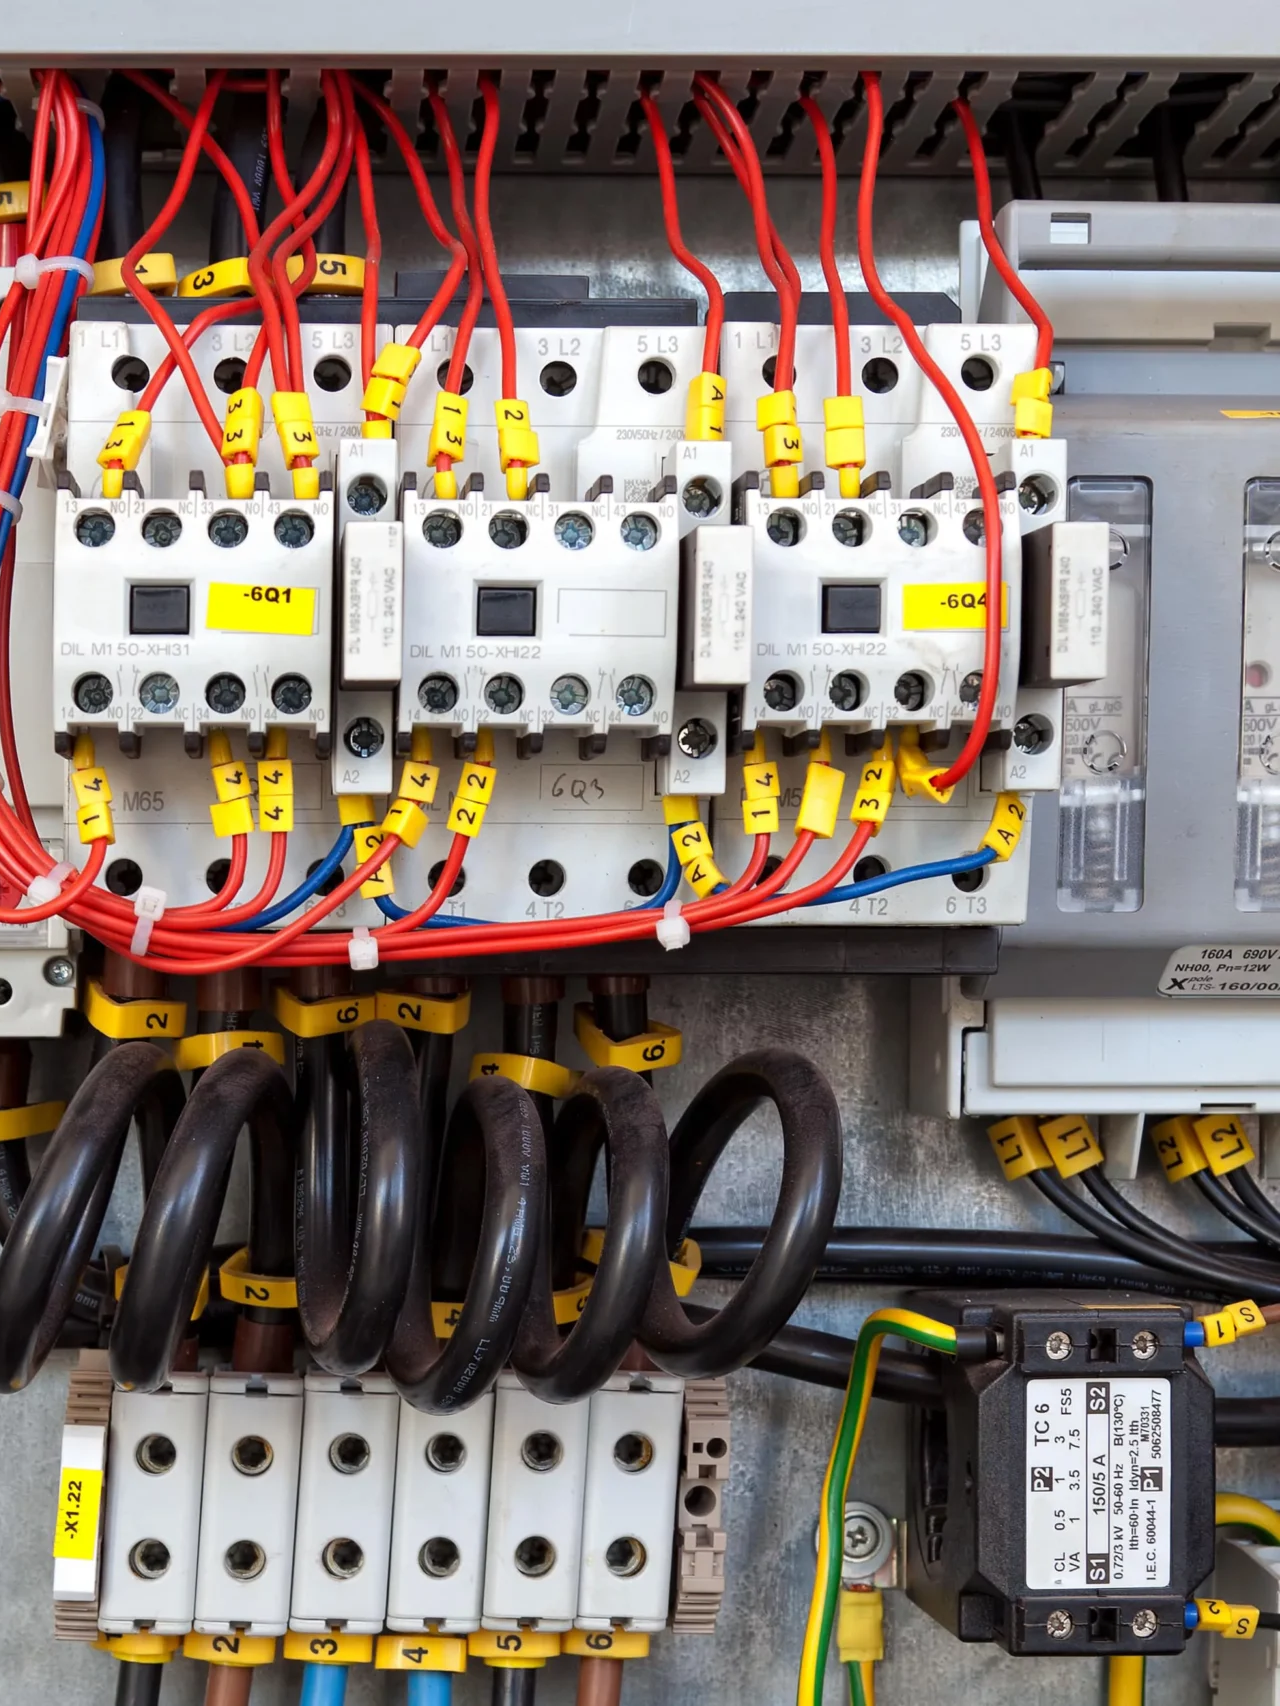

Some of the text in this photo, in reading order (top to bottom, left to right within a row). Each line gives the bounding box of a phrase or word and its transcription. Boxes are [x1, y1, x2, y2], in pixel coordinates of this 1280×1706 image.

[320, 260, 346, 275] 5
[193, 272, 214, 290] 3
[101, 331, 119, 347] L1
[212, 334, 222, 351] 3
[312, 332, 354, 349] 5 L3
[538, 339, 580, 355] 3 L2
[637, 336, 678, 353] 5 L3
[861, 337, 902, 354] 3 L2
[961, 334, 1002, 350] 5 L3
[349, 444, 364, 456] A1
[684, 447, 696, 460] A1
[1020, 445, 1033, 456] A1
[314, 503, 328, 515] NO
[244, 587, 291, 604] -6Q1
[940, 594, 987, 609] -6Q4
[61, 644, 84, 655] DIL
[410, 646, 432, 658] DIL
[758, 644, 779, 656] DIL
[62, 706, 74, 718] 14
[108, 707, 123, 719] NO
[131, 707, 143, 720] 22
[175, 708, 188, 720] NC
[197, 708, 209, 720] 34
[241, 708, 256, 720] NO
[264, 708, 277, 720] 44
[310, 709, 324, 721] NO
[408, 710, 420, 721] 14
[343, 771, 359, 783] A2
[674, 770, 690, 783] A2
[1010, 766, 1026, 779] A2
[123, 791, 164, 811] M65
[525, 902, 565, 918] 4 T2
[849, 898, 888, 915] 4 T2
[946, 896, 987, 913] 6 T3
[1201, 949, 1233, 959] 160A
[1175, 964, 1271, 972] NH00, Pn=12W
[398, 1002, 421, 1021] 2
[146, 1012, 168, 1029] 2
[997, 1133, 1022, 1164] L1
[1058, 1126, 1091, 1159] L1
[1211, 1123, 1244, 1159] L2
[1159, 1136, 1182, 1170] L2
[245, 1285, 269, 1300] 2
[1061, 1388, 1072, 1415] FS5
[1141, 1406, 1150, 1442] M70331
[1152, 1390, 1162, 1459] 5062508477
[1034, 1403, 1050, 1490] P2 TC 6
[1069, 1429, 1080, 1450] 7.5
[1114, 1464, 1123, 1478] Hz
[1144, 1468, 1159, 1490] P1
[1070, 1470, 1080, 1490] 3.5
[1090, 1387, 1106, 1581] S1 150/5 A S2
[1114, 1483, 1123, 1515] 50-60
[64, 1480, 82, 1539] -X1.22
[1055, 1510, 1065, 1530] 0.5
[1114, 1526, 1123, 1541] kV
[1147, 1500, 1156, 1580] I.E.C. 60044-1
[1055, 1552, 1065, 1571] CL
[1070, 1551, 1080, 1572] VA
[1114, 1545, 1123, 1579] 0.72/3
[213, 1636, 239, 1653] 2
[310, 1639, 337, 1655] 3
[497, 1635, 522, 1651] 5
[402, 1647, 428, 1663] 4
